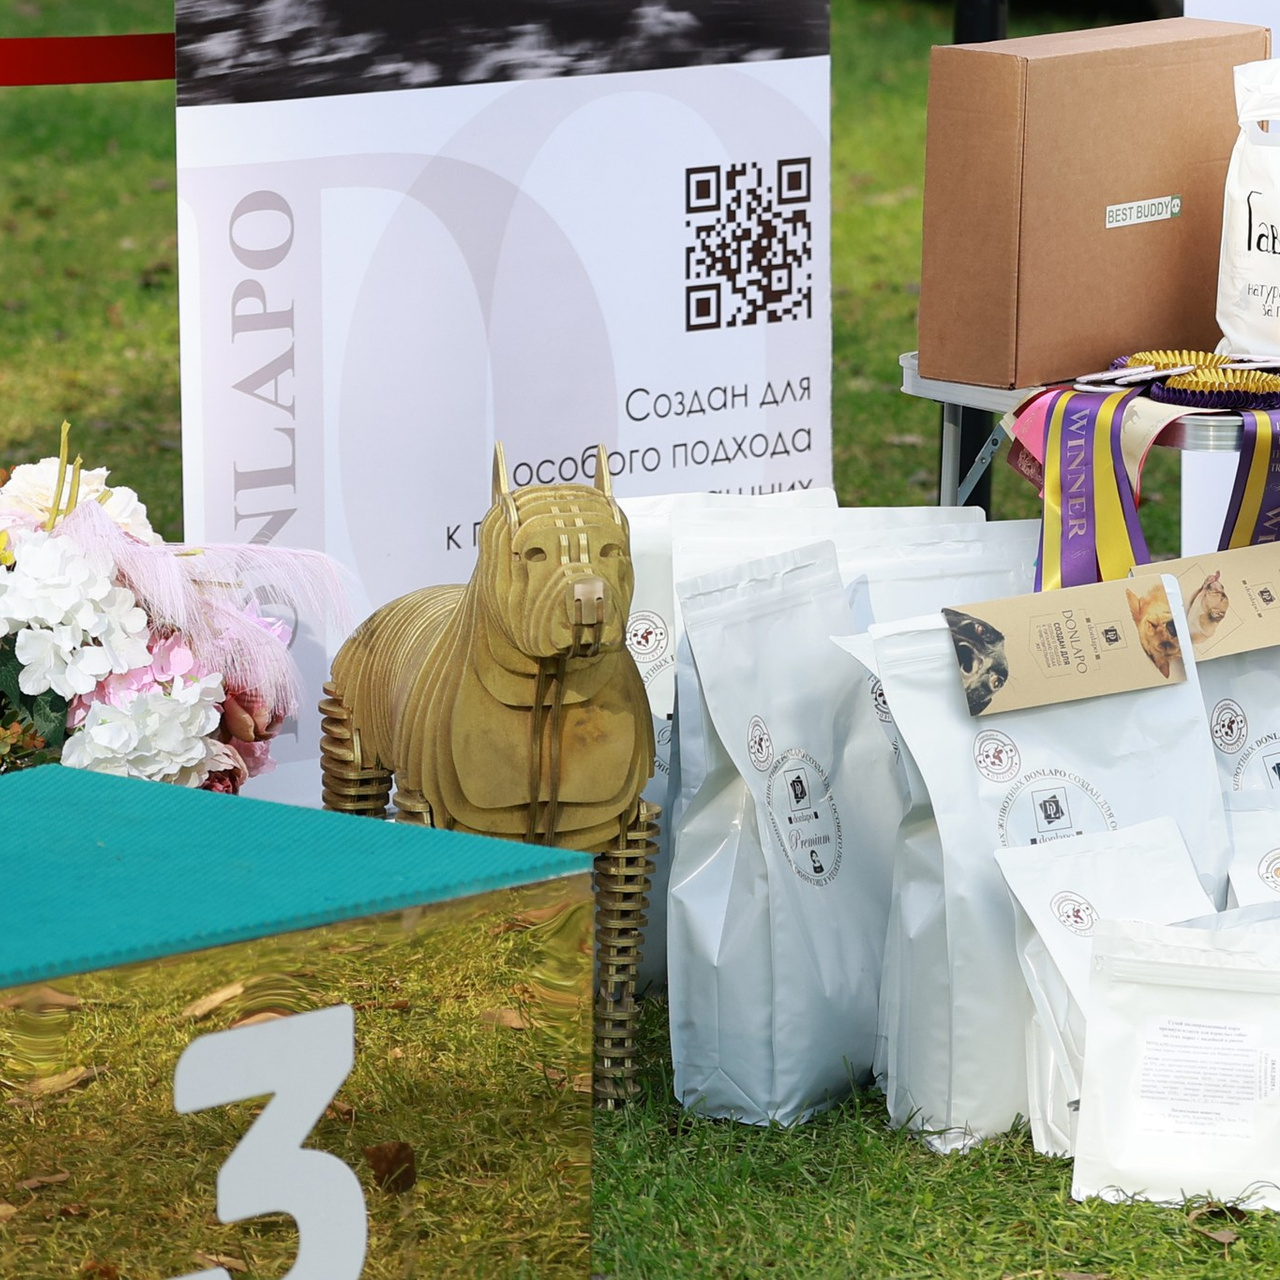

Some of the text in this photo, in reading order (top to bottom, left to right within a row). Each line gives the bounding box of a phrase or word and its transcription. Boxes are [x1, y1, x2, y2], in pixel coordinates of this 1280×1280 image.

[1107, 201, 1171, 224] BEST BUDDY
[1262, 304, 1274, 317] за
[625, 376, 811, 422] Создан для
[513, 443, 661, 487] особого
[672, 427, 812, 469] подхода
[1067, 408, 1091, 540] WINNER
[446, 524, 462, 551] к
[1054, 622, 1070, 665] СОЗДАН ДЛЯ
[1062, 610, 1087, 674] DONLAPO
[1024, 768, 1067, 783] DONLAPO
[788, 828, 831, 852] Premium
[174, 1003, 368, 1280] 3
